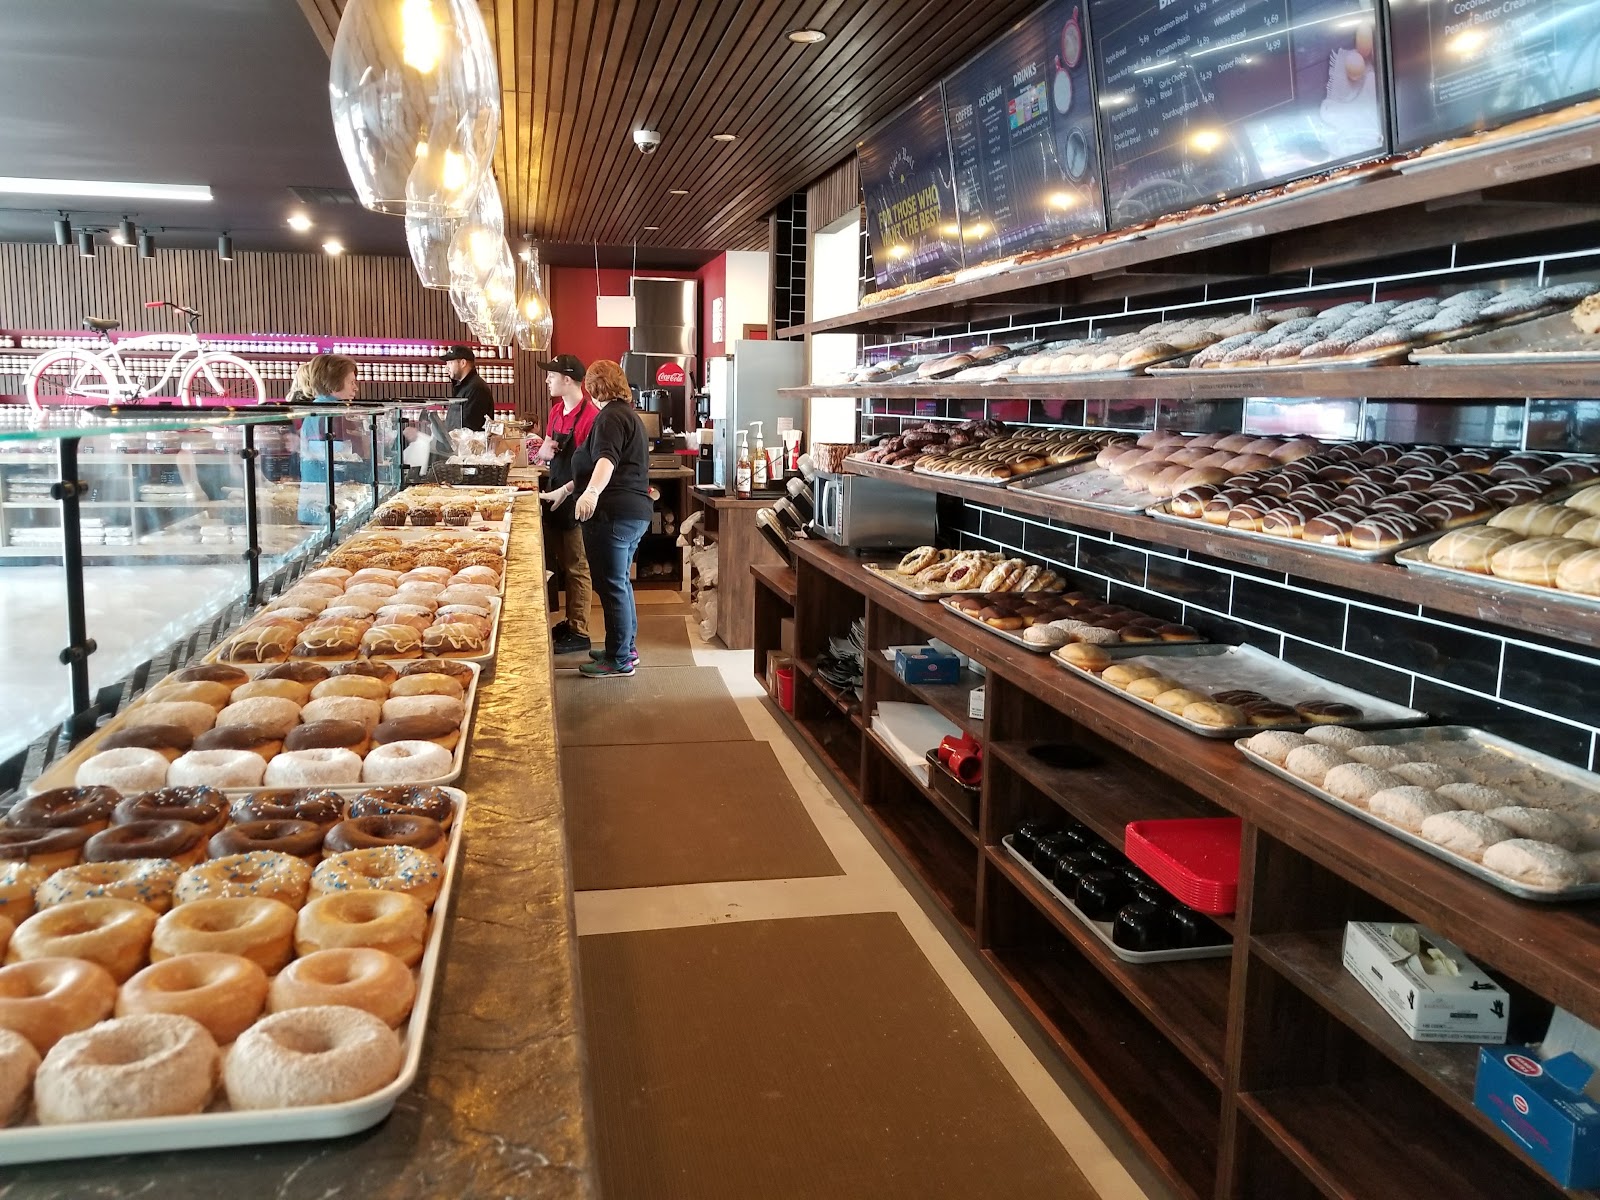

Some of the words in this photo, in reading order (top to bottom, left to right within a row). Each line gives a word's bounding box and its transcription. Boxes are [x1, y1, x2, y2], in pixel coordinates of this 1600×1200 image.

[1154, 20, 1176, 37] Cinnamon
[1175, 10, 1189, 25] Bread
[1213, 12, 1231, 27] Wheat
[1230, 3, 1246, 19] Bread
[1264, 14, 1279, 27] $4.69
[1445, 17, 1473, 36] Peanut
[1474, 5, 1502, 25] Butter
[1156, 42, 1178, 58] Cinnamon
[1177, 34, 1191, 47] Raisin
[1230, 27, 1247, 41] Bread
[1265, 39, 1281, 52] $4.99
[1116, 46, 1127, 59] Bread
[1013, 62, 1037, 88] DRINKS
[1217, 60, 1235, 74] Dinner
[978, 95, 987, 109] ICE
[986, 85, 1003, 103] CREAM
[1184, 97, 1199, 111] Bread
[955, 104, 974, 124] COFFEE
[878, 207, 894, 230] FOR
[892, 194, 917, 222] THOSE
[917, 183, 939, 212] WHO
[880, 222, 901, 247] WANT
[901, 215, 920, 238] THE
[919, 204, 940, 231] BEST
